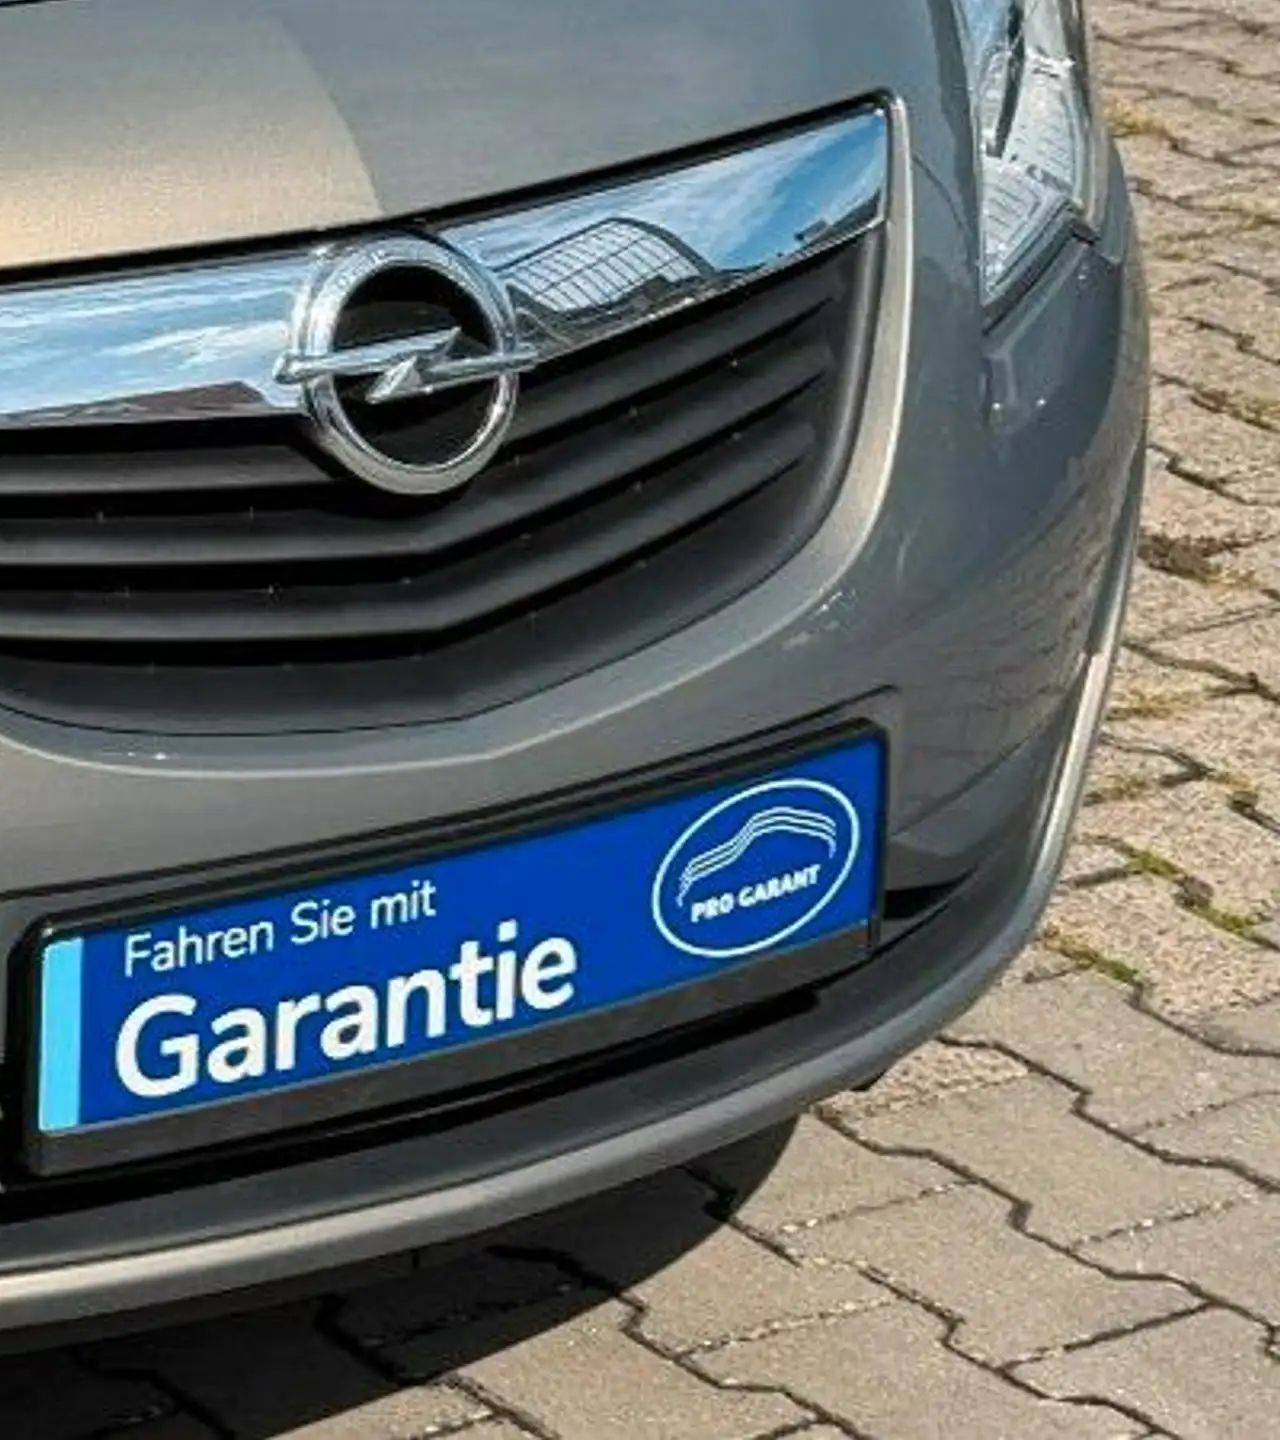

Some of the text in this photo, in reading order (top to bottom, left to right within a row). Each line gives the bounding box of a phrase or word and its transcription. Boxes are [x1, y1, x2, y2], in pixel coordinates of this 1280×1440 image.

[124, 879, 437, 978] Fahren Sie mit
[690, 864, 821, 923] PRO GARANT
[115, 920, 579, 1099] Garantie
